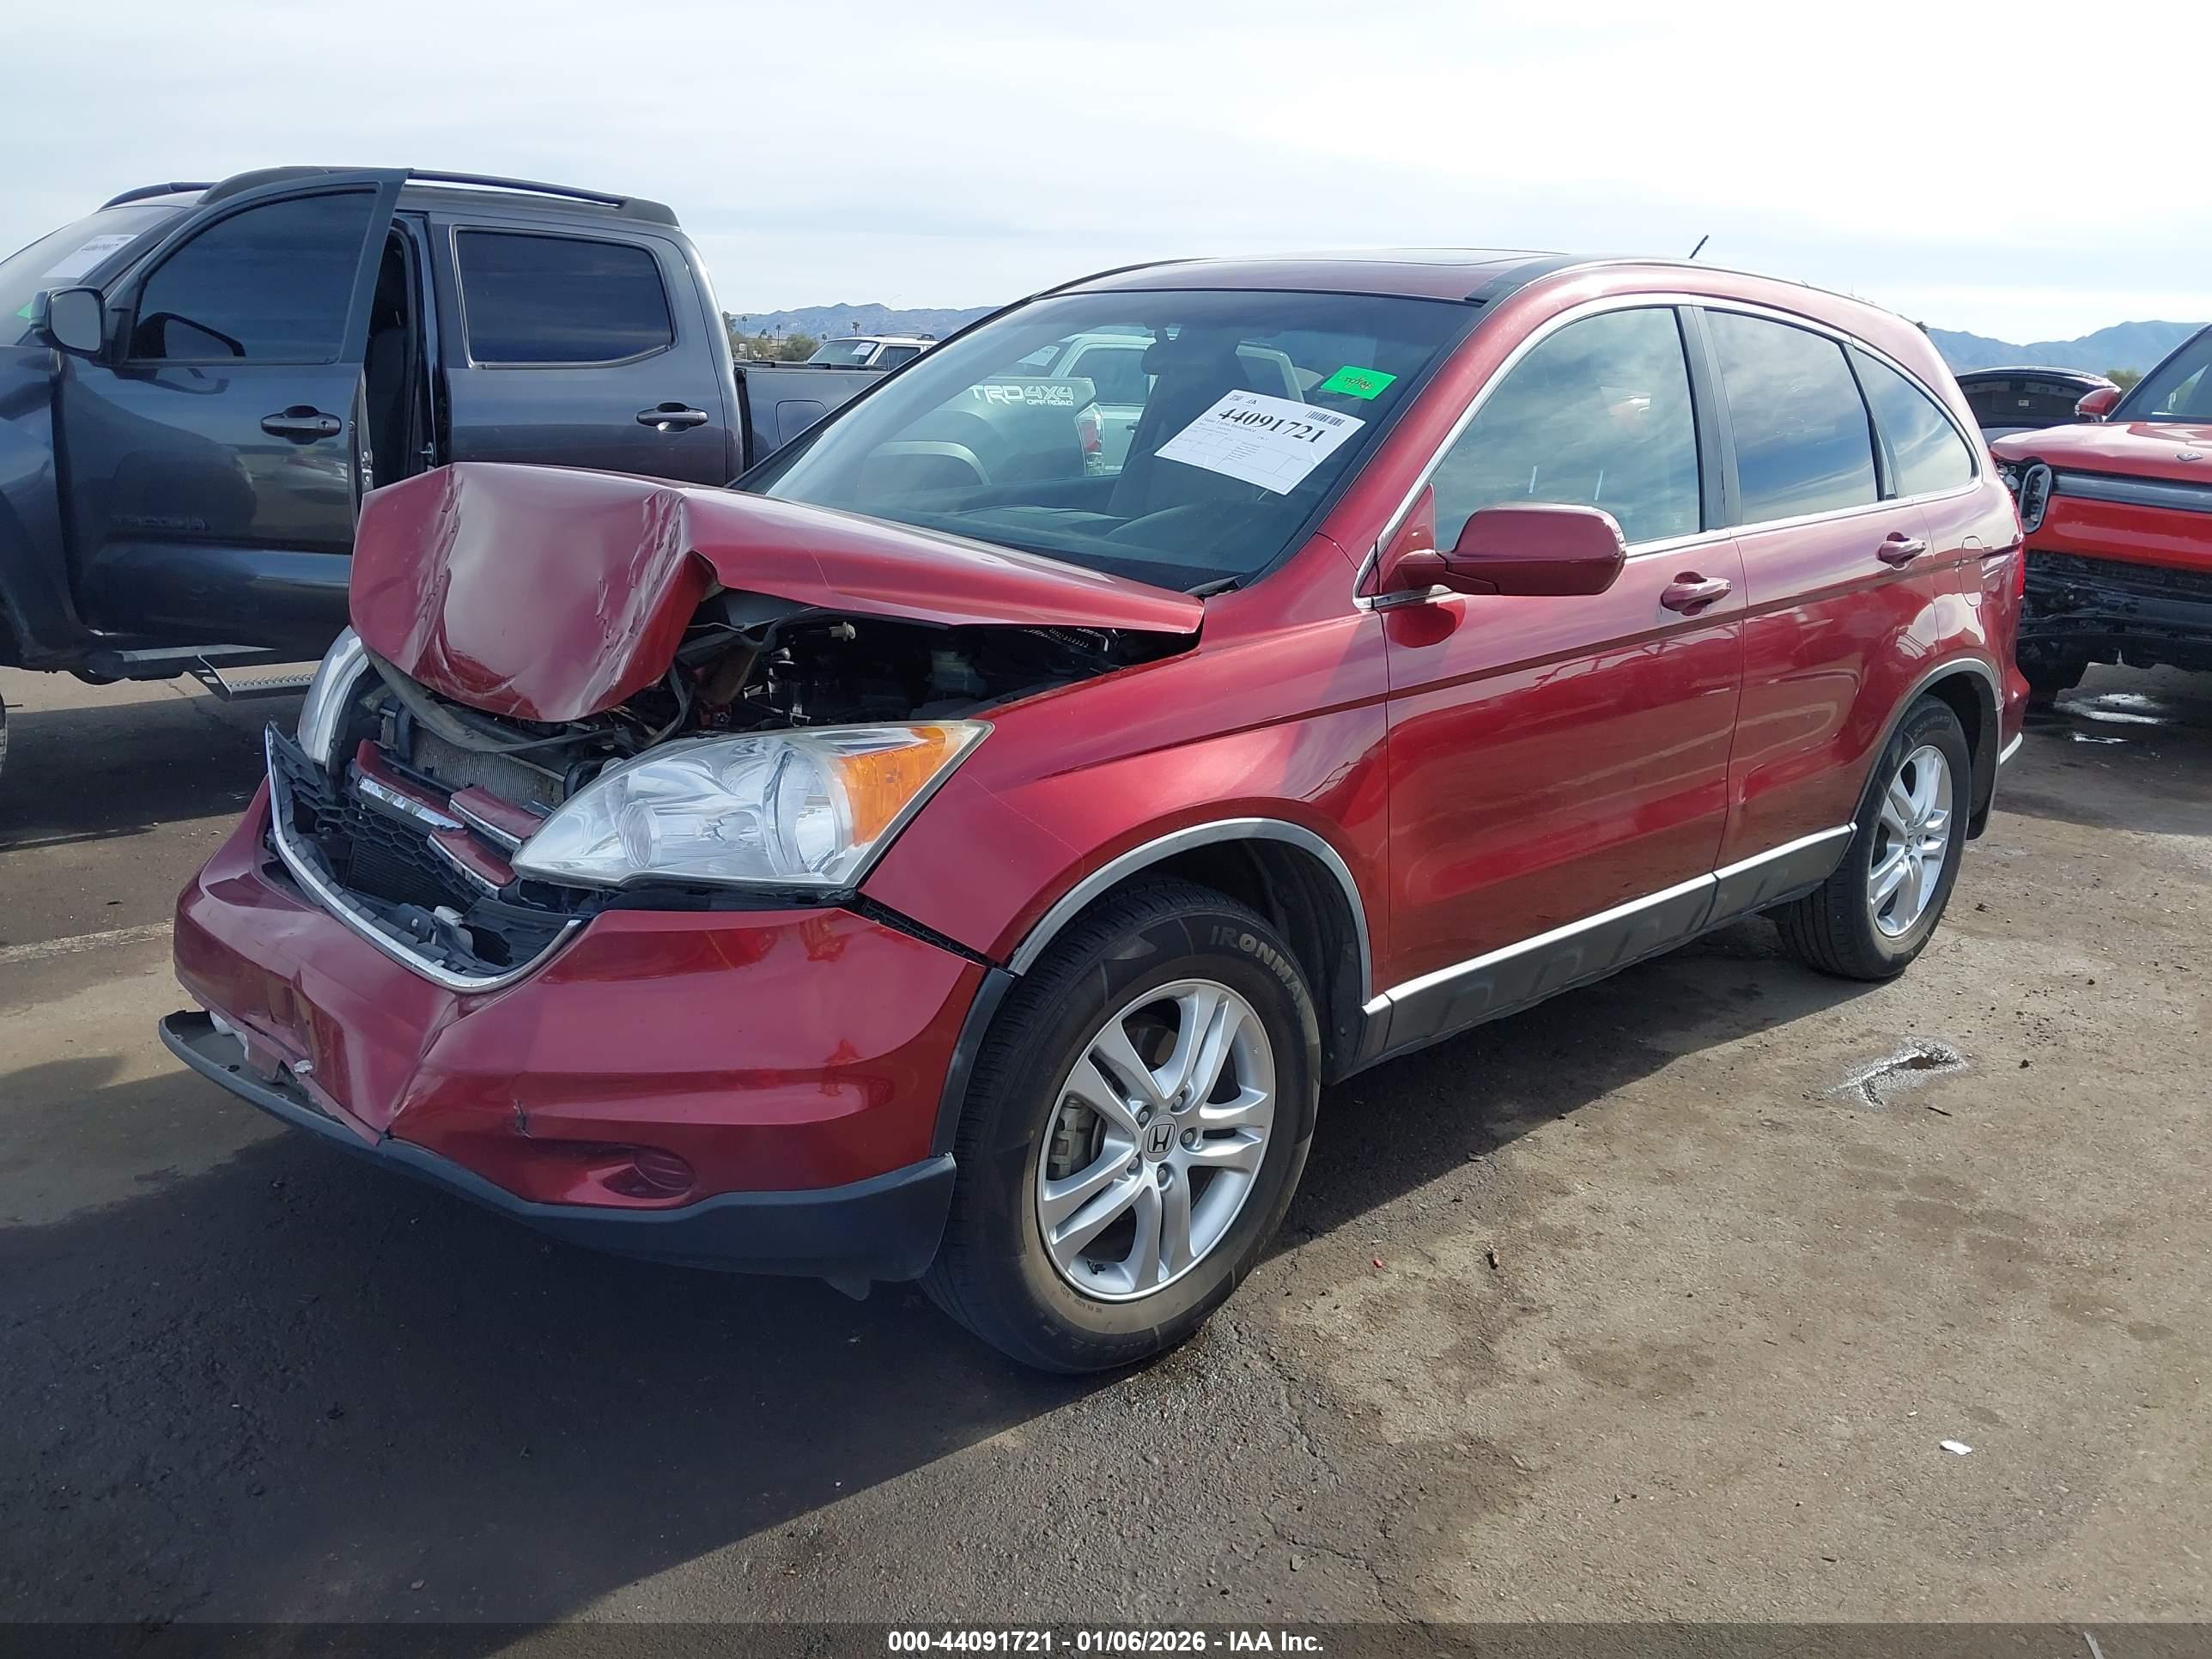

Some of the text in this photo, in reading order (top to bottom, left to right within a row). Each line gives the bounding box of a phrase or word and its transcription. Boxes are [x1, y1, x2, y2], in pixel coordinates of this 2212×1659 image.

[969, 385, 1073, 405] TRD 4X4
[1218, 408, 1327, 443] 44091721
